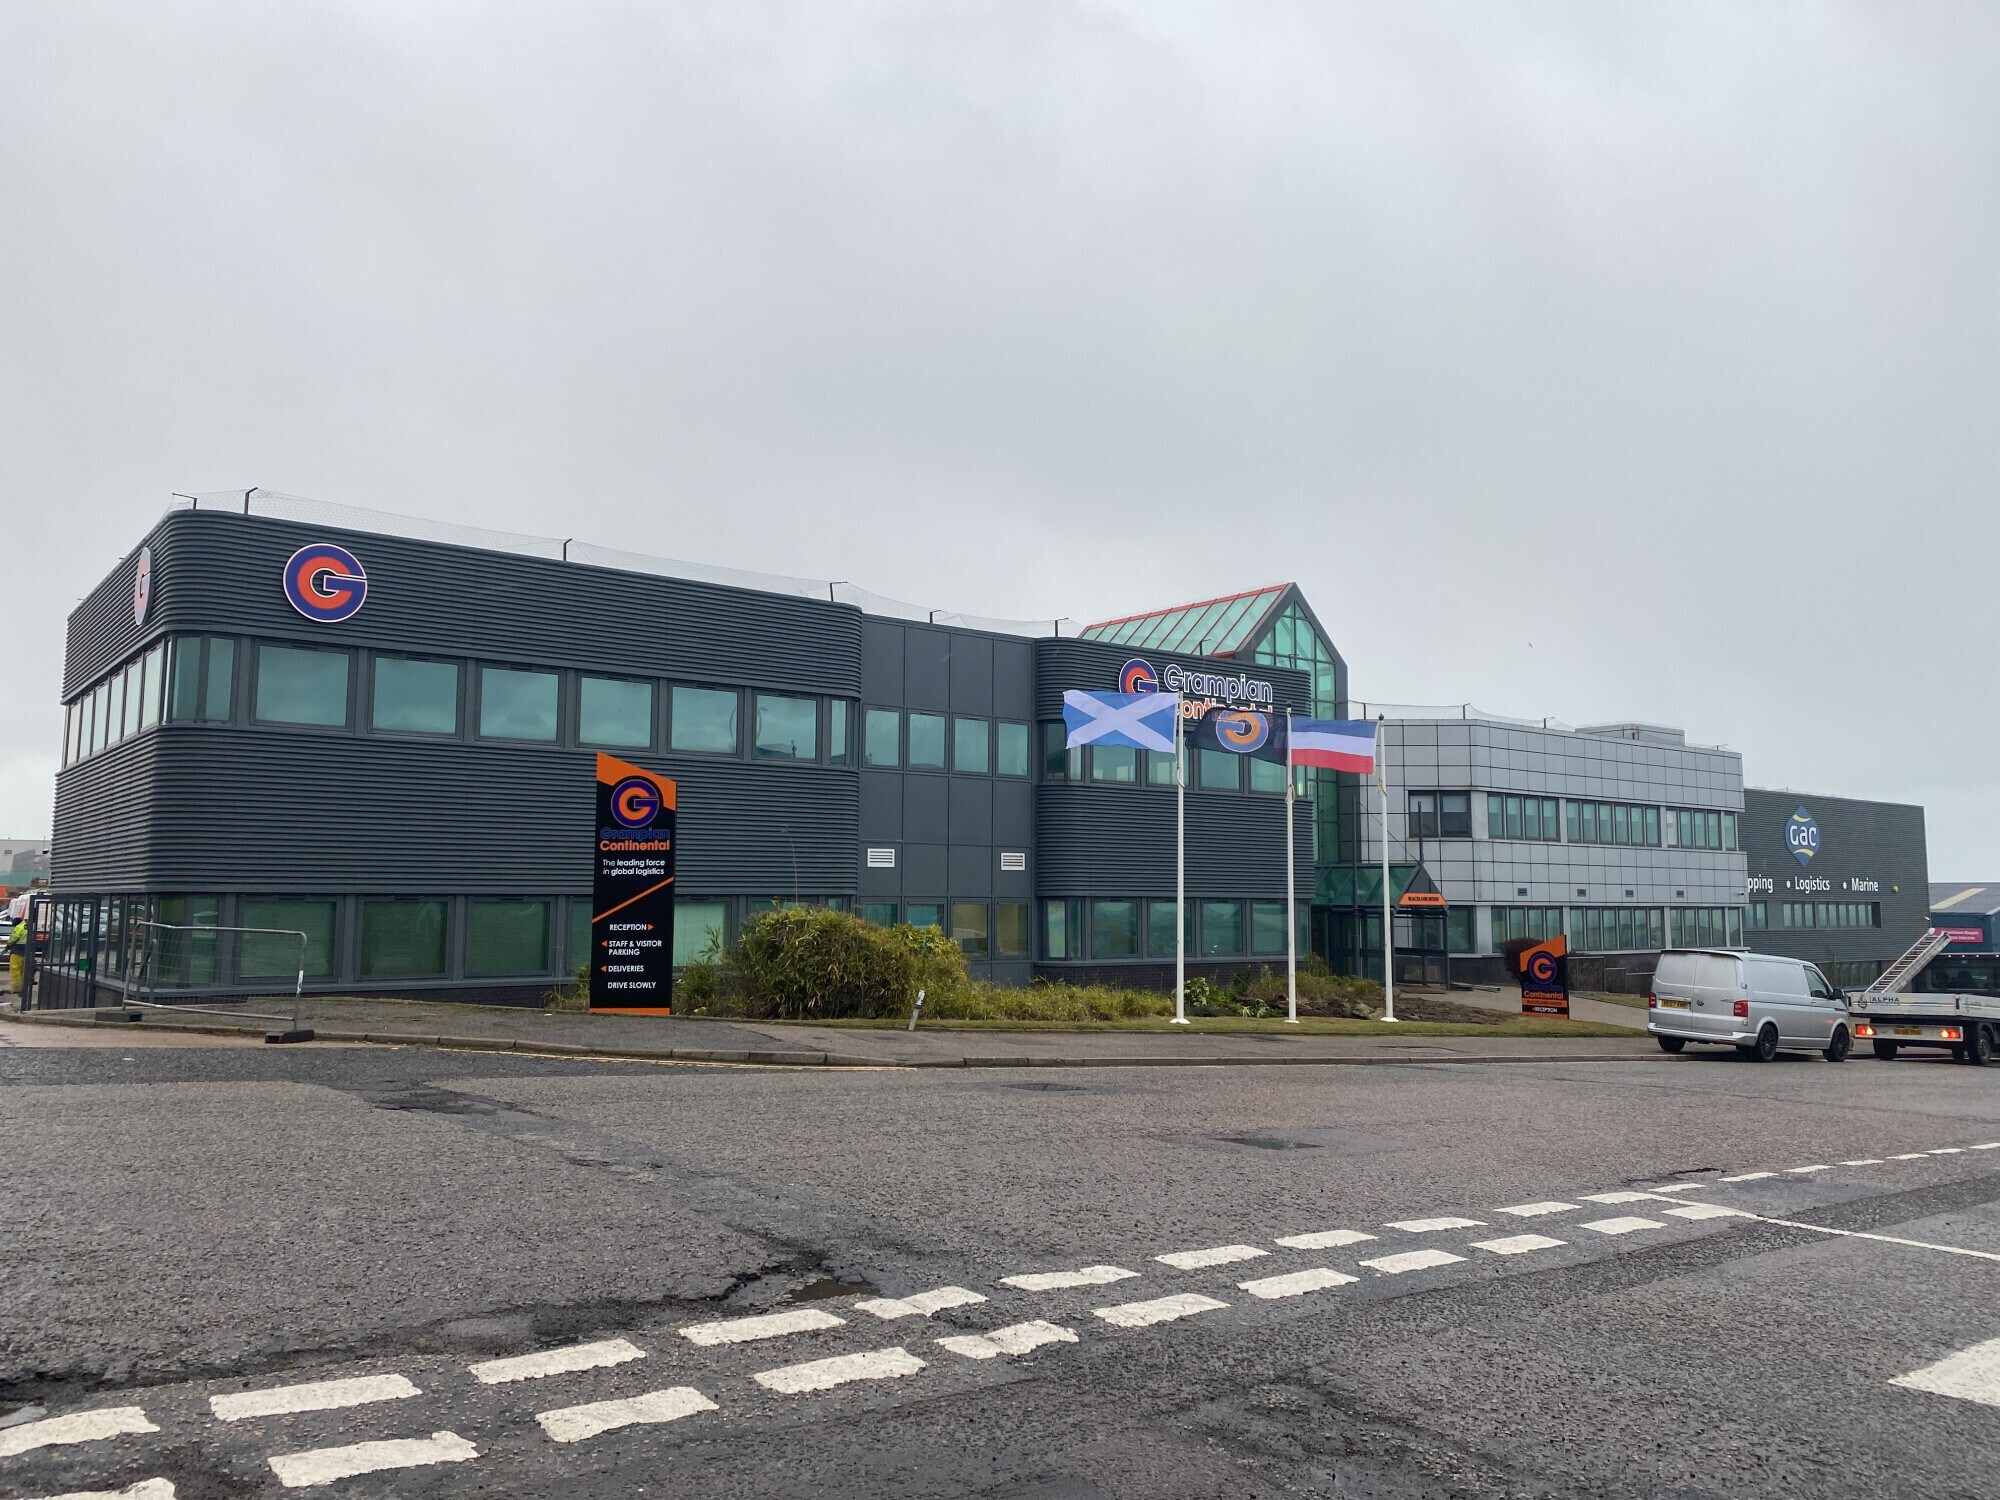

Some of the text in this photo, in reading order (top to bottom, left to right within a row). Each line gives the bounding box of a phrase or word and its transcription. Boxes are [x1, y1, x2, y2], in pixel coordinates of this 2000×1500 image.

[1163, 664, 1273, 703] Grampian
[600, 826, 671, 841] Grampian
[600, 839, 670, 851] Continental
[603, 859, 666, 869] The leading force
[603, 867, 665, 877] in global logistics
[1795, 876, 1830, 894] Logistics
[1851, 878, 1879, 892] Marine
[608, 940, 628, 948] STAFF
[629, 940, 635, 948] &
[608, 948, 640, 956] PARKING
[608, 965, 644, 973] DELIVERIES
[607, 981, 657, 989] DRIVE SLOWLY
[1524, 990, 1564, 999] Continental
